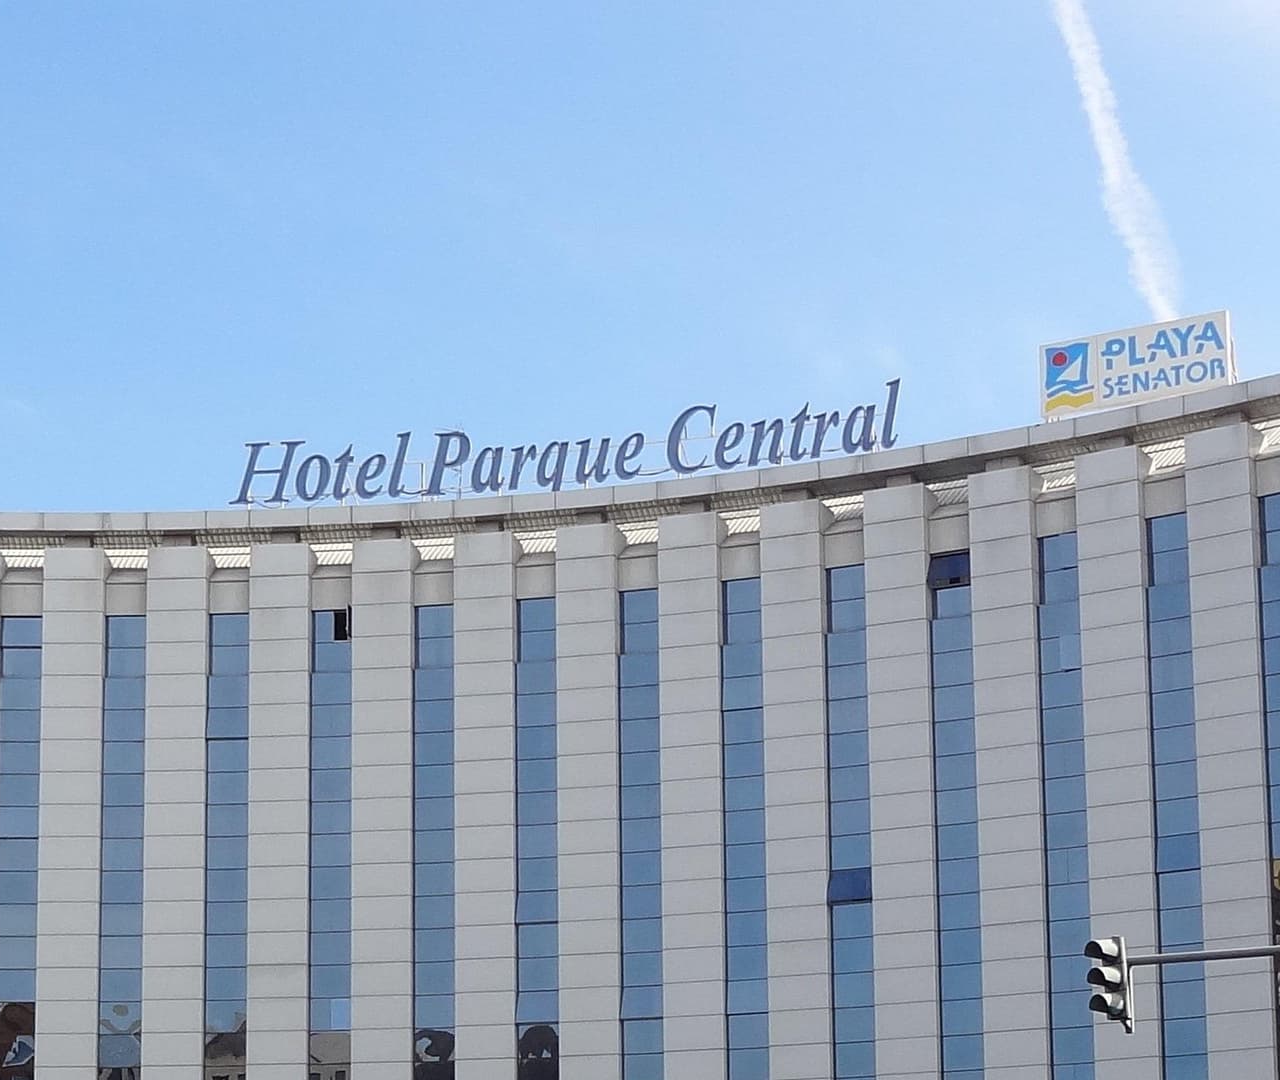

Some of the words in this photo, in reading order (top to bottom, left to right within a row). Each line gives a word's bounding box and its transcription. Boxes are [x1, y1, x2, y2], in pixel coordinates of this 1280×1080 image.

[1101, 320, 1225, 370] PLAYA
[1102, 357, 1226, 399] SENATOR
[229, 431, 412, 505] Hotel
[421, 430, 645, 492] Parque
[666, 377, 901, 474] Central
